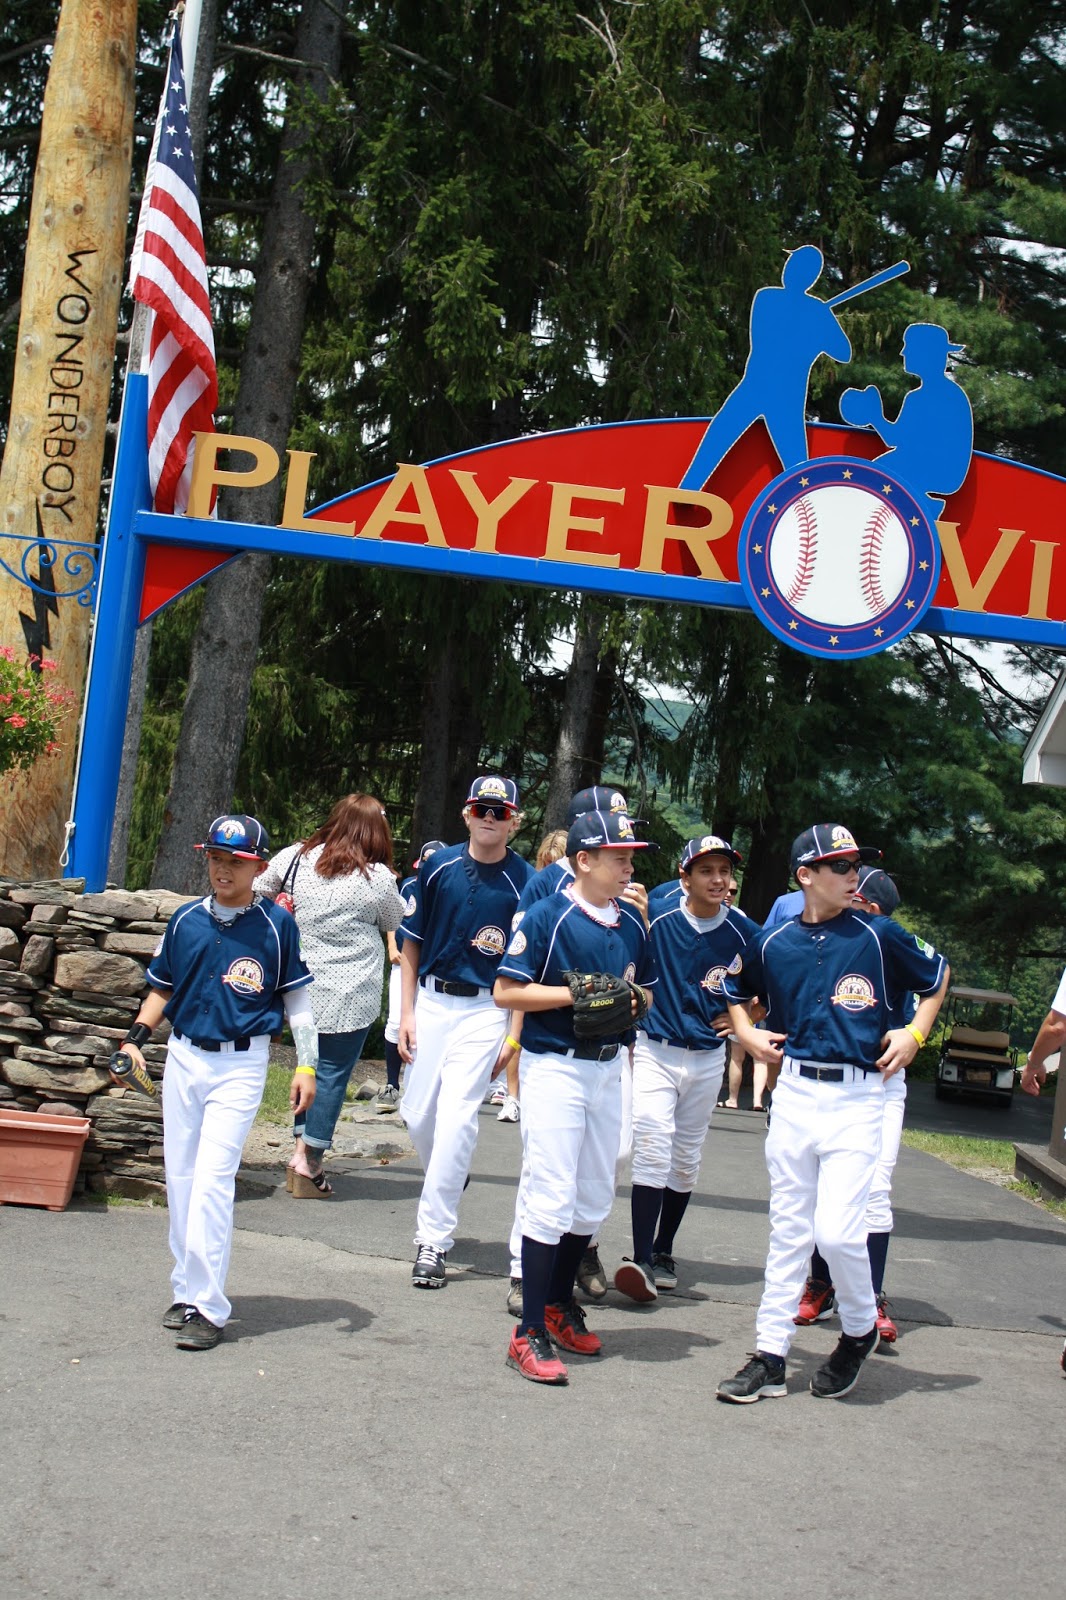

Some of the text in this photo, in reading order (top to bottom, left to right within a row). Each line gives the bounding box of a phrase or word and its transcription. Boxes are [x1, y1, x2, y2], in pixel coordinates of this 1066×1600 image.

[43, 249, 97, 522] WONDERBOY
[181, 430, 1066, 622] PLAYER VI
[589, 998, 615, 1008] A2000
